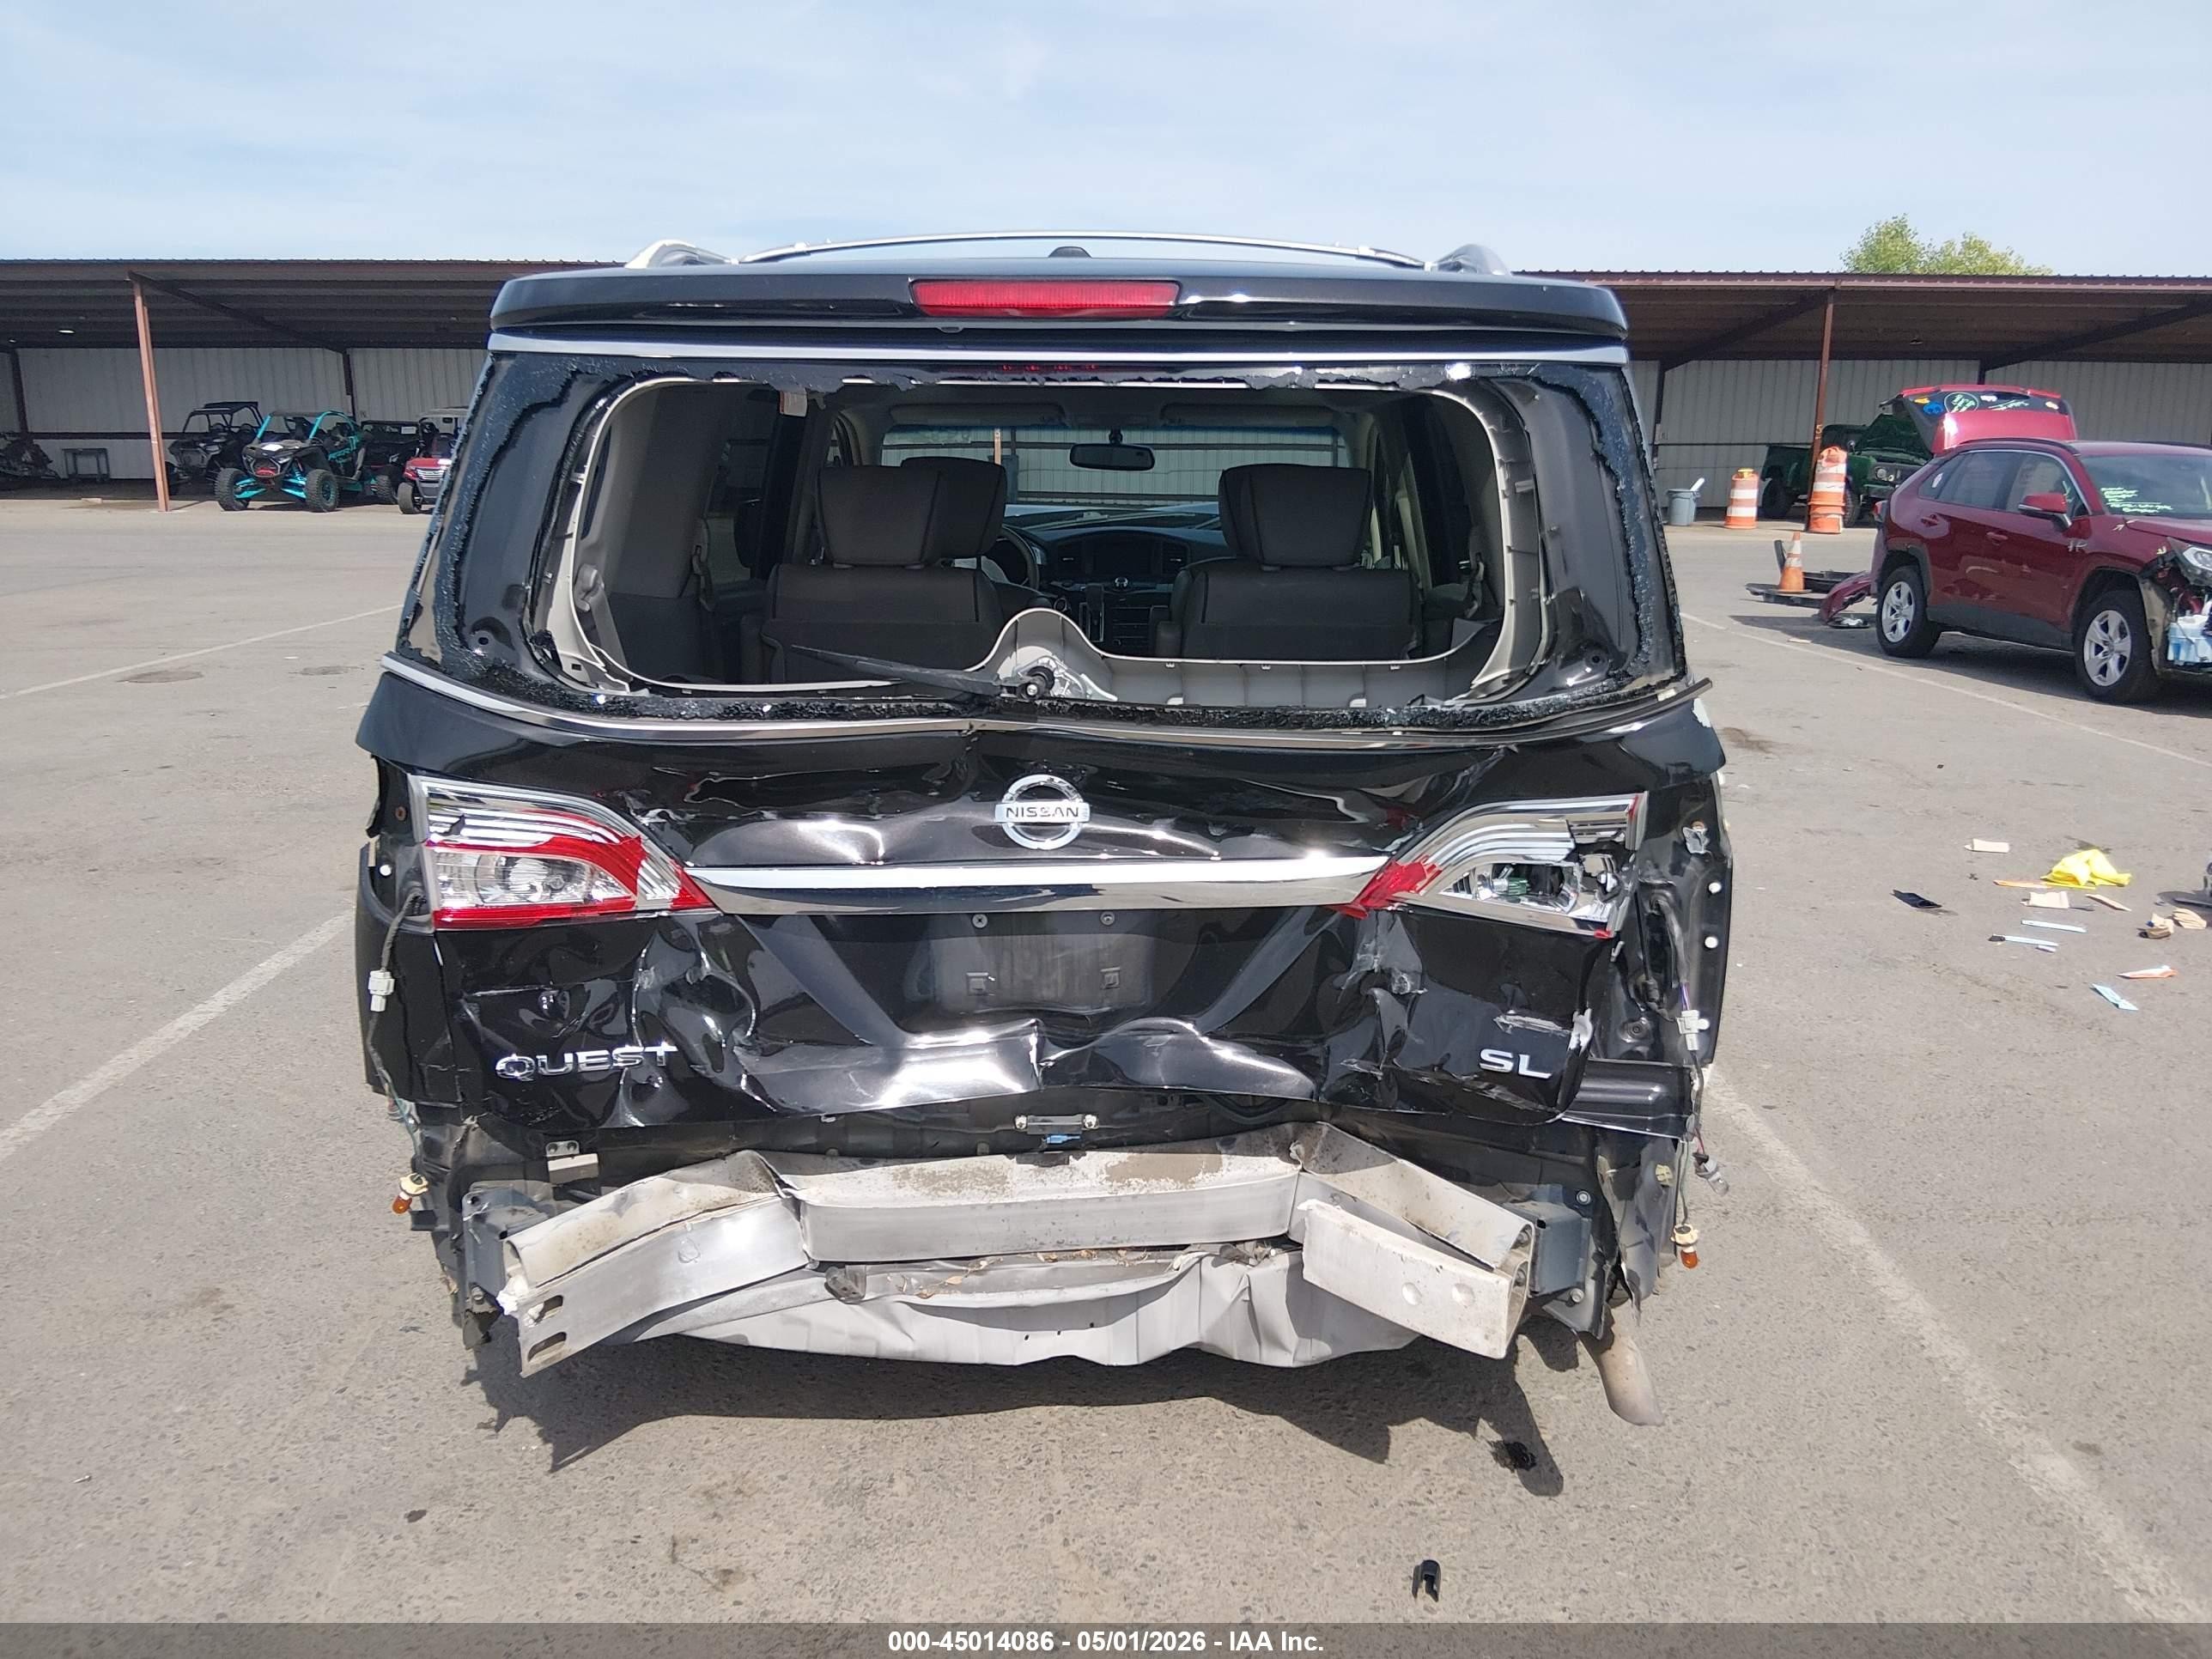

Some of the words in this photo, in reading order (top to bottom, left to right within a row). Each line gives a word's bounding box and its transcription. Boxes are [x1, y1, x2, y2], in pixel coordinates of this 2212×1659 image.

[1006, 806, 1079, 817] NISSAN
[495, 1041, 678, 1082] QUEST
[1479, 1048, 1553, 1079] SL
